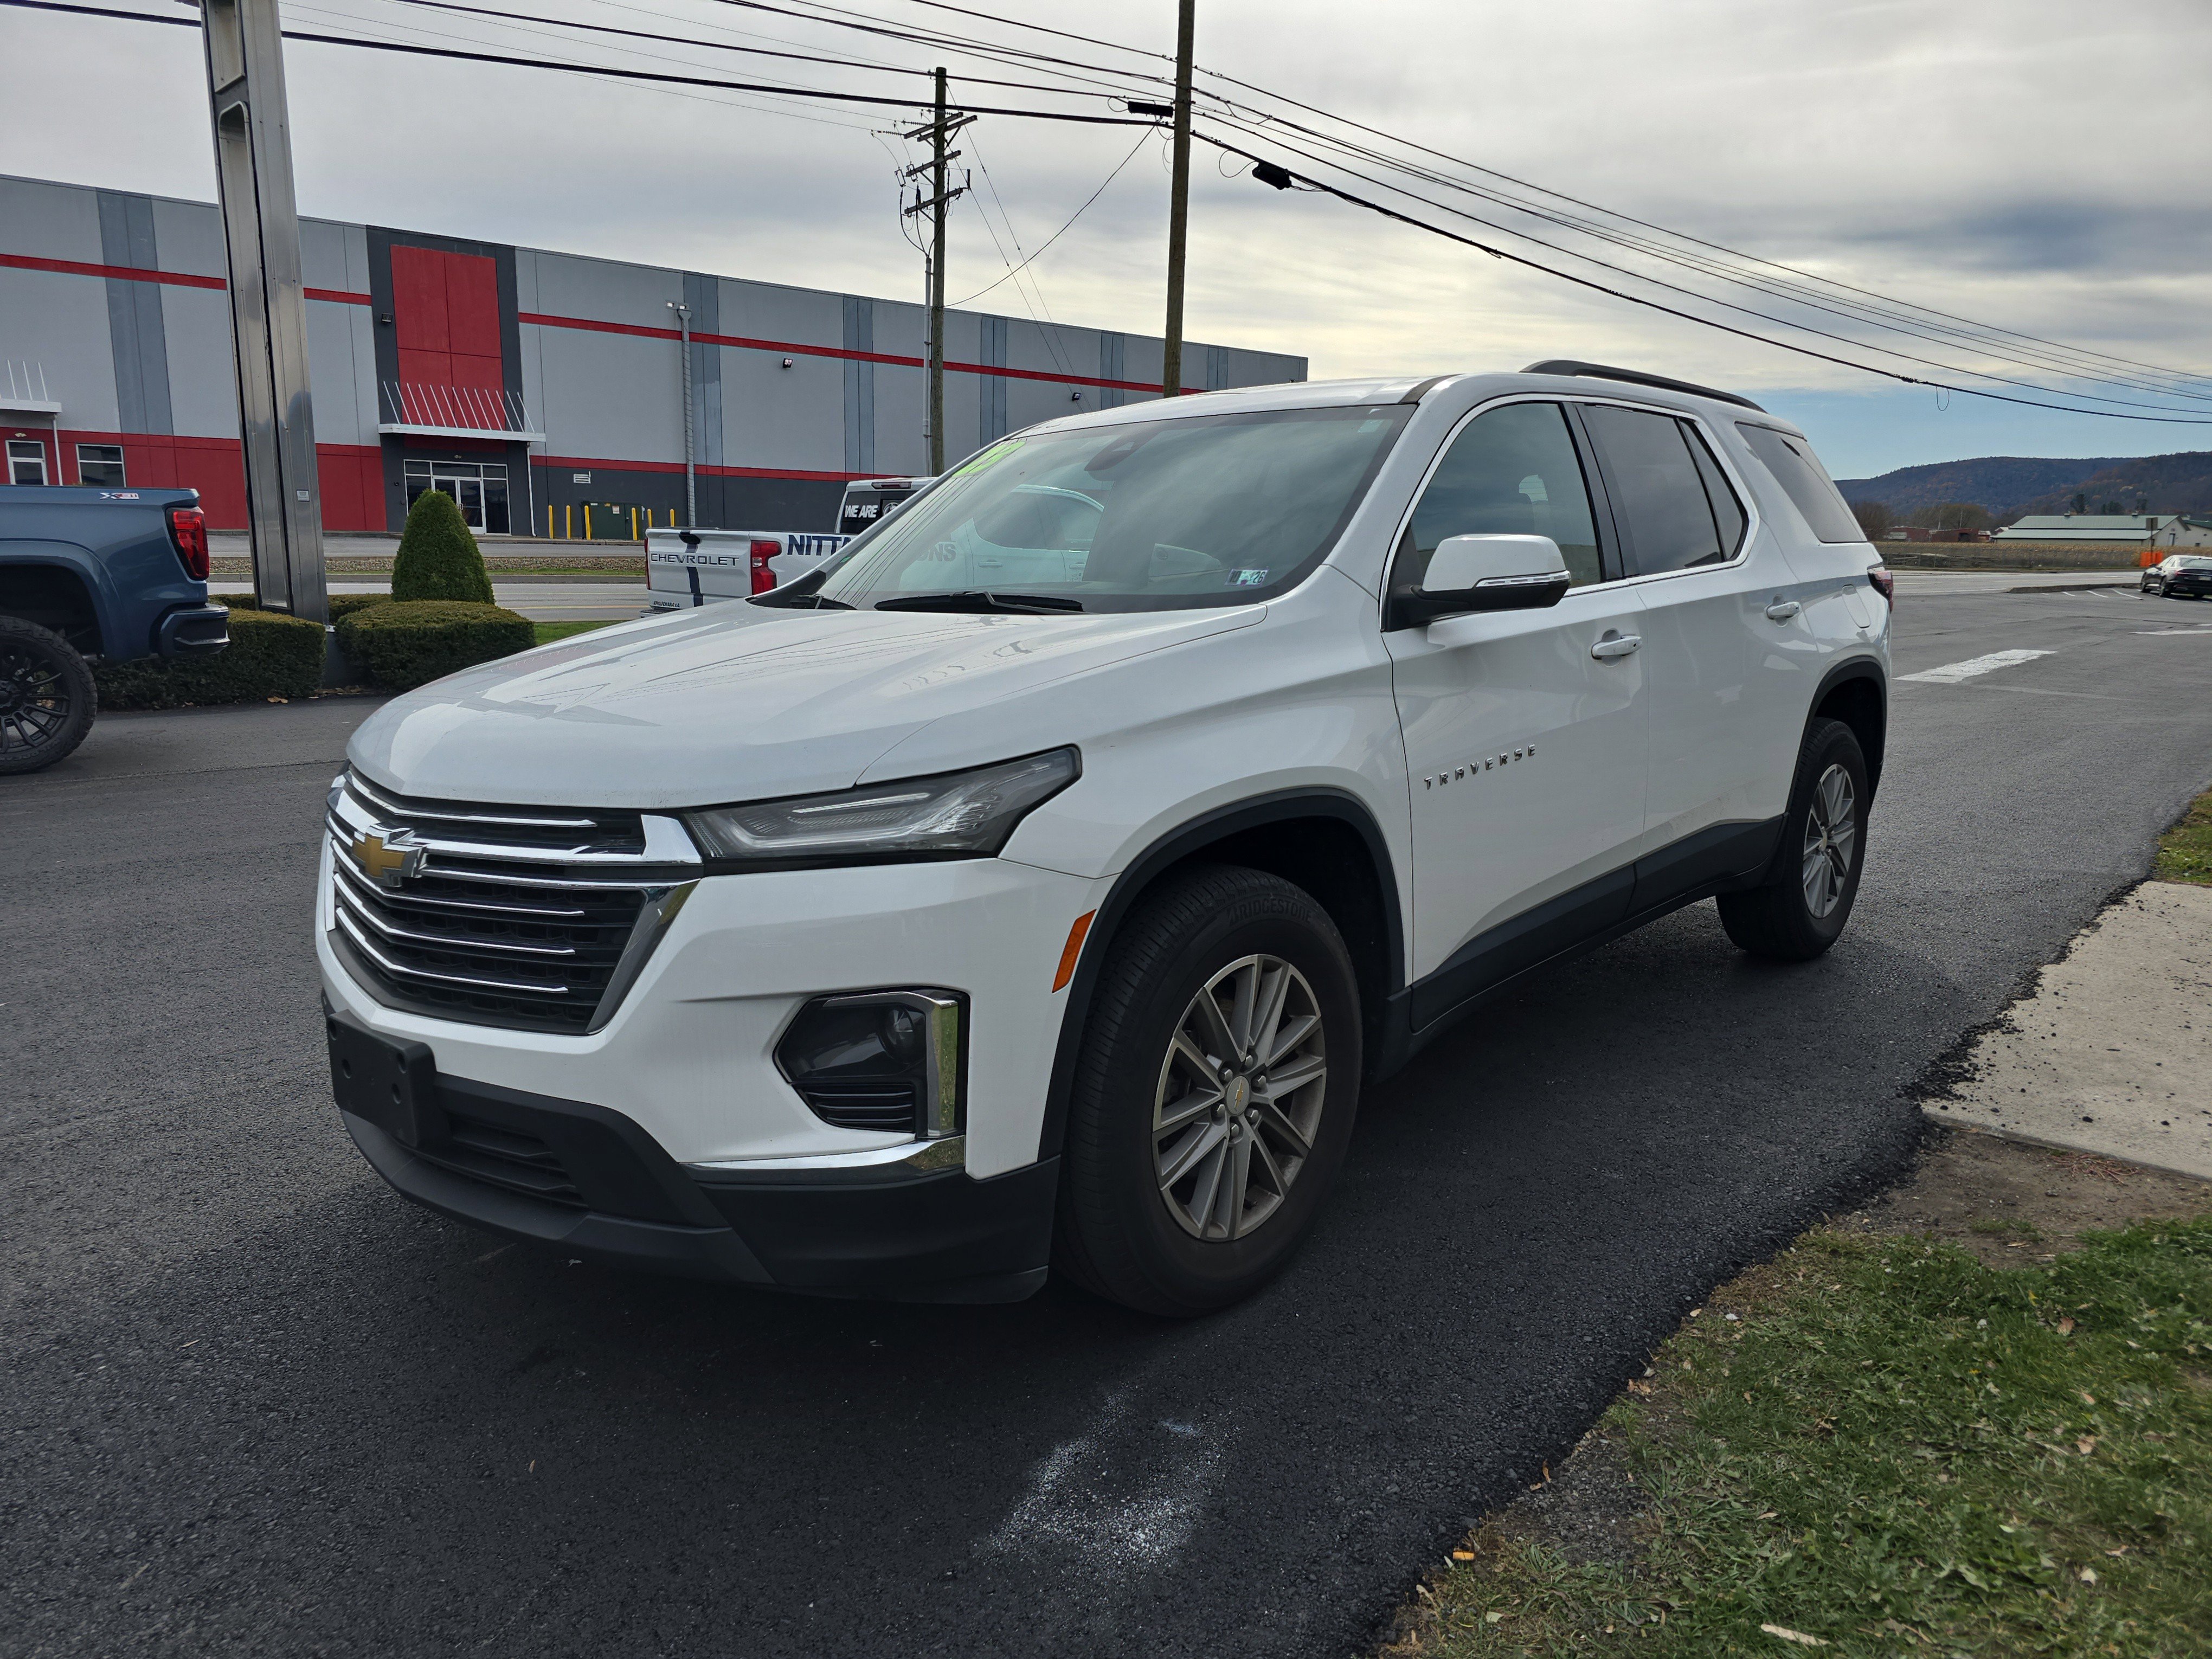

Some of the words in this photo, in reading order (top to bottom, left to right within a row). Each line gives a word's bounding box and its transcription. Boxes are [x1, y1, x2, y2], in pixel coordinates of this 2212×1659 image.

[845, 505, 859, 518] WE
[858, 505, 878, 518] ARE
[651, 553, 740, 567] CHEVROLET
[1252, 571, 1266, 584] 26
[1424, 744, 1536, 790] TRAVERSE
